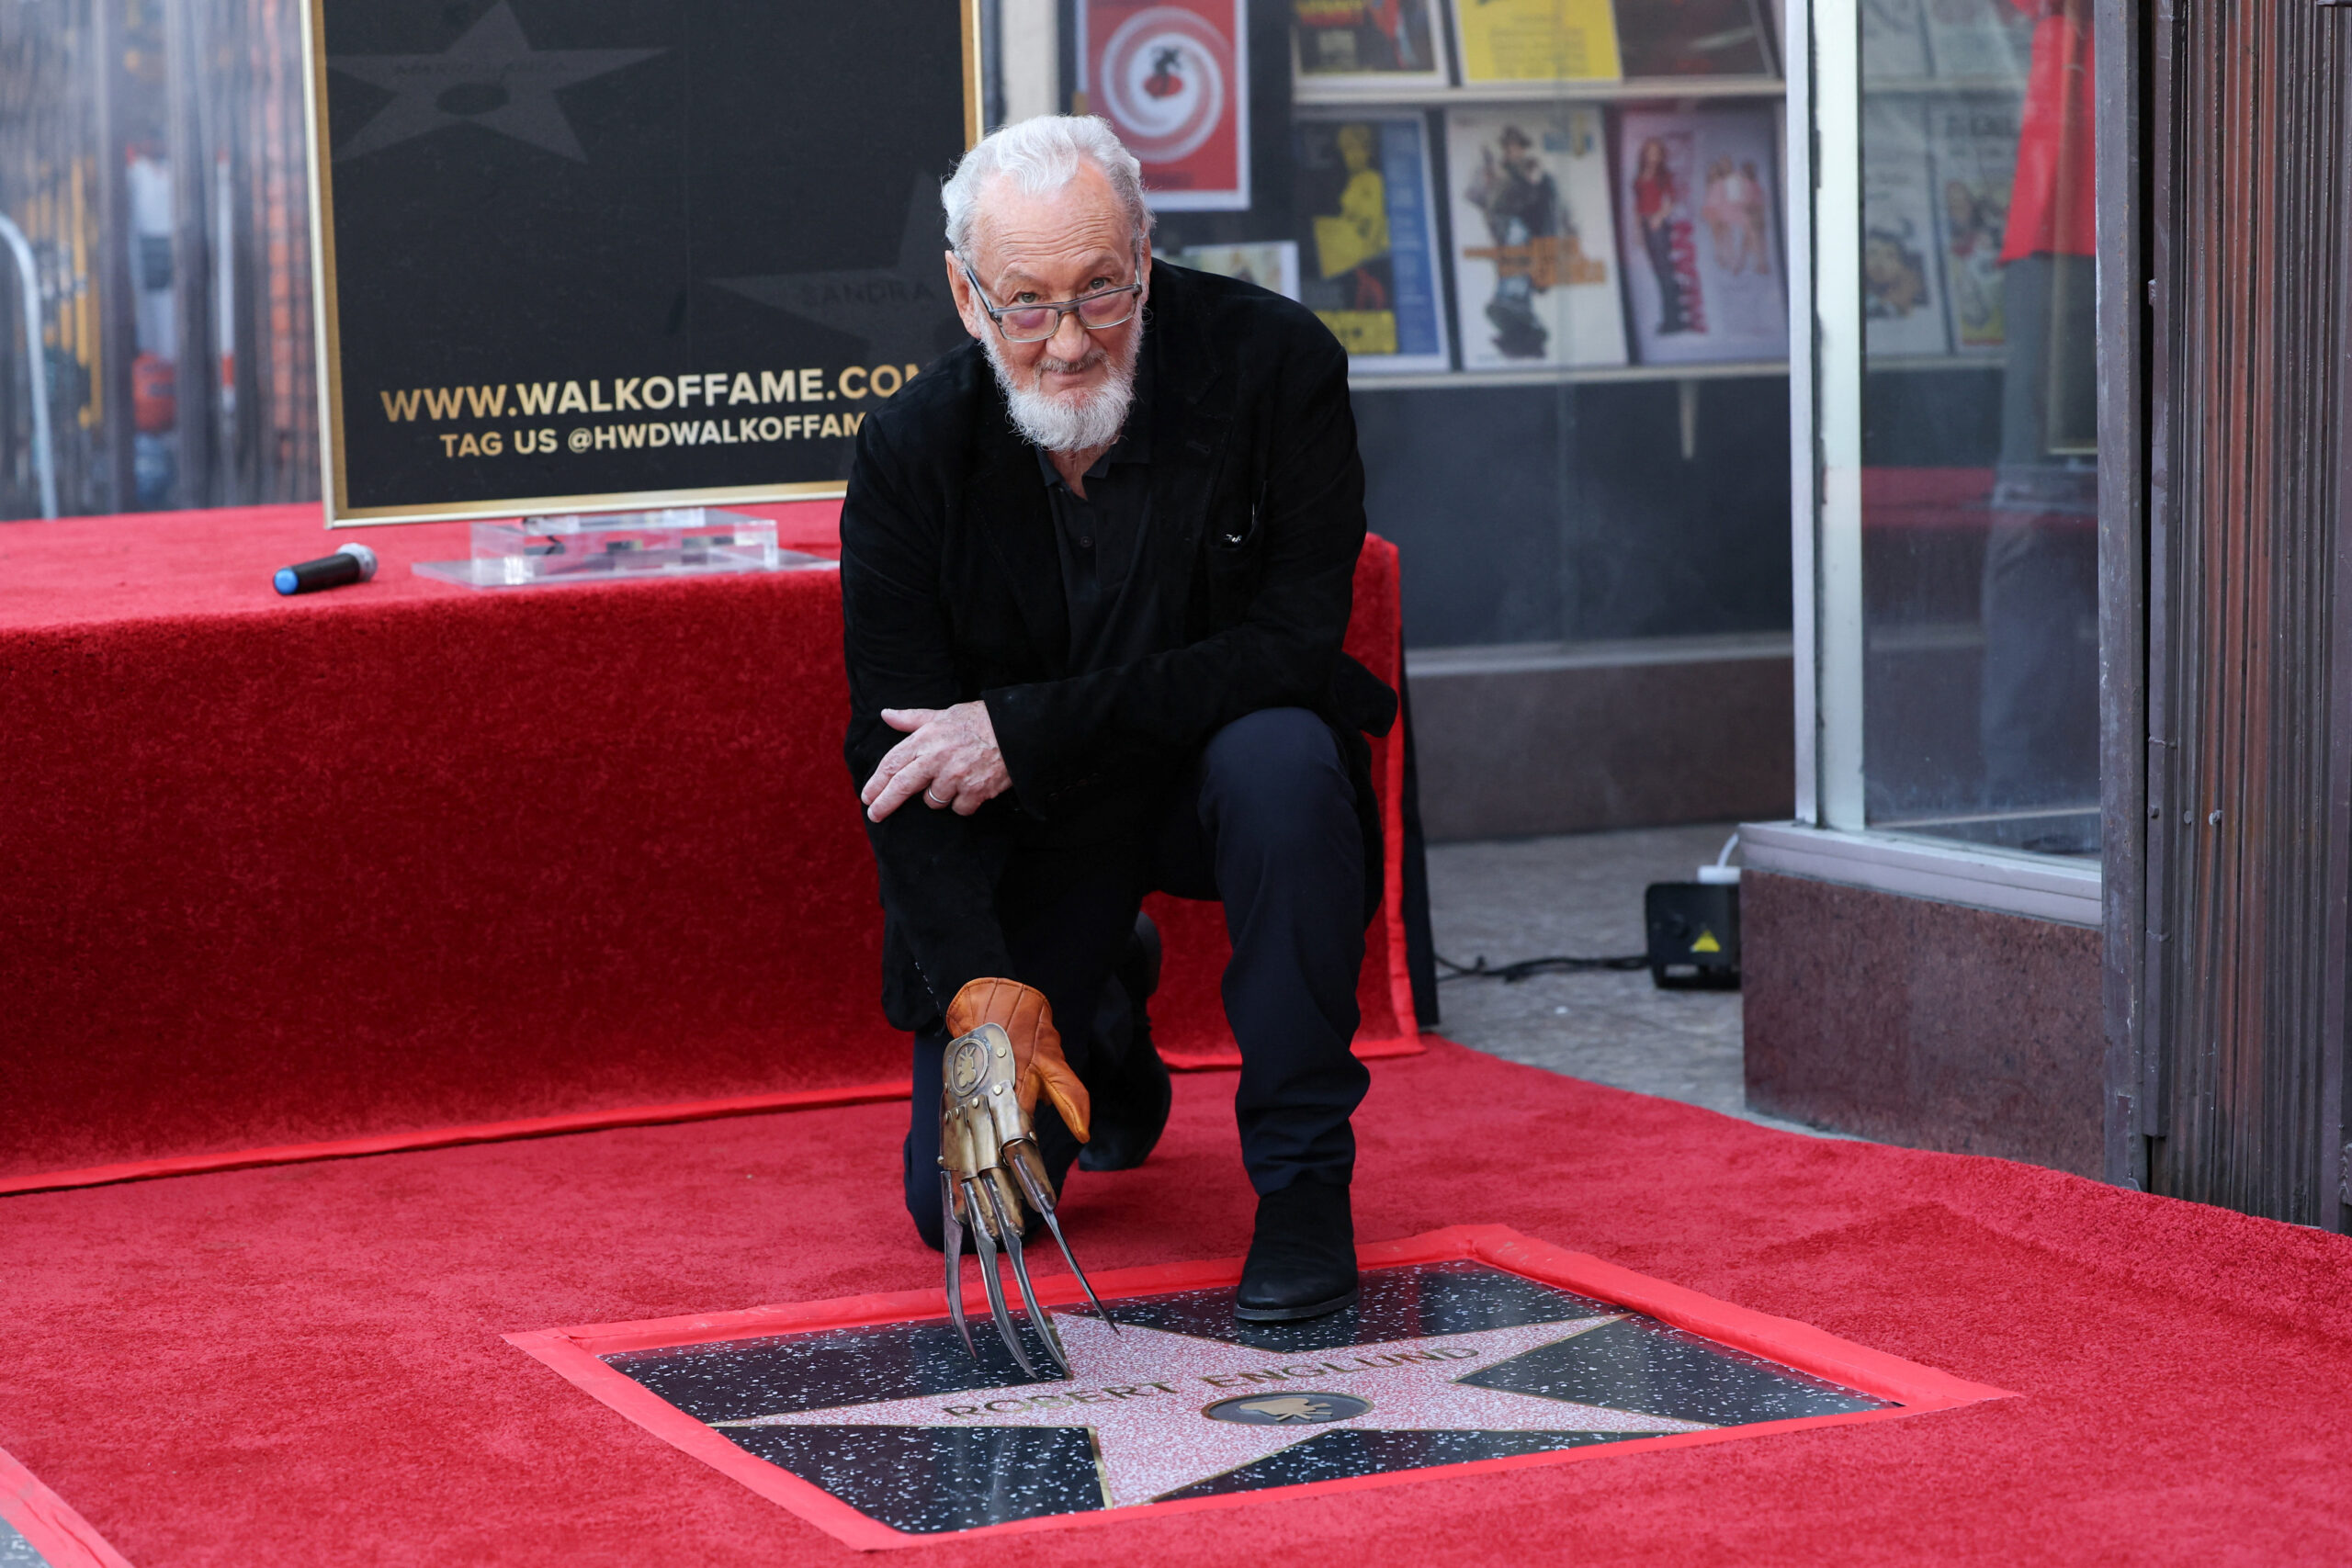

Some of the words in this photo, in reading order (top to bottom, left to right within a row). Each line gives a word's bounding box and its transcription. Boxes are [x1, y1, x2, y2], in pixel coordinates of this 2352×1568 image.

[800, 279, 936, 307] SANDRA
[439, 431, 503, 458] TAG
[514, 427, 559, 456] US
[567, 412, 867, 454] @HWDWALKOFFAM
[942, 1381, 1178, 1420] ROBERT
[1204, 1347, 1479, 1388] ENGLUND
